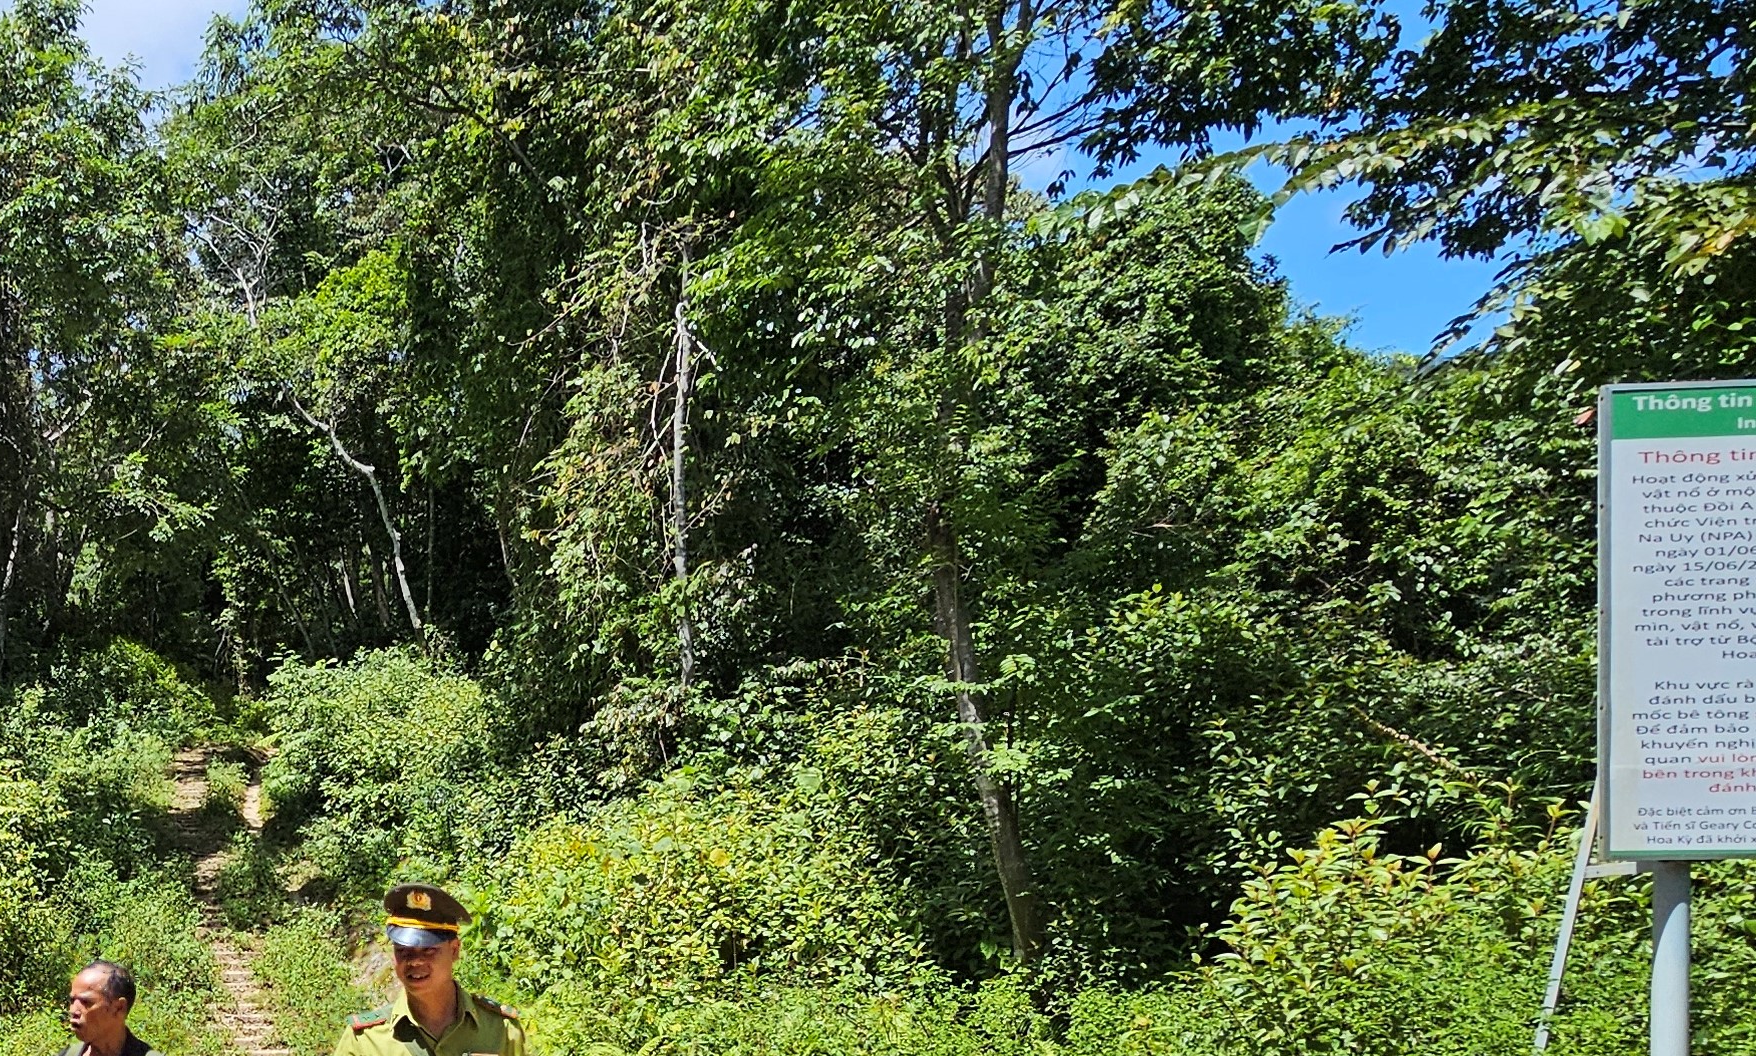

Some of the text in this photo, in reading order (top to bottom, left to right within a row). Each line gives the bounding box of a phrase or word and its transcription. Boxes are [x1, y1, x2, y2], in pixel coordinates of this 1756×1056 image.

[1632, 393, 1753, 412] Thông tin
[1638, 450, 1720, 465] Thông
[1633, 473, 1730, 484] Hoạt động
[1643, 489, 1671, 500] vật
[1643, 504, 1697, 513] thuộc
[1740, 502, 1753, 510] A
[1645, 517, 1737, 528] chức Viện
[1639, 531, 1753, 543] Na Uy (NPA)
[1655, 548, 1698, 559] ngày
[1633, 563, 1676, 574] ngày
[1665, 577, 1750, 587] các trang
[1653, 592, 1727, 603] phương
[1643, 609, 1692, 617] trong
[1682, 621, 1709, 631] vật
[1646, 638, 1669, 646] tài
[1655, 681, 1689, 690] Khu
[1696, 681, 1730, 690] vực
[1649, 696, 1696, 705] đánh
[1707, 710, 1749, 720] tông
[1645, 754, 1725, 765] quan vui
[1643, 770, 1734, 779] bên trong
[1666, 806, 1692, 817] biệt
[1699, 820, 1739, 830] Geary
[1647, 836, 1672, 844] Hoa
